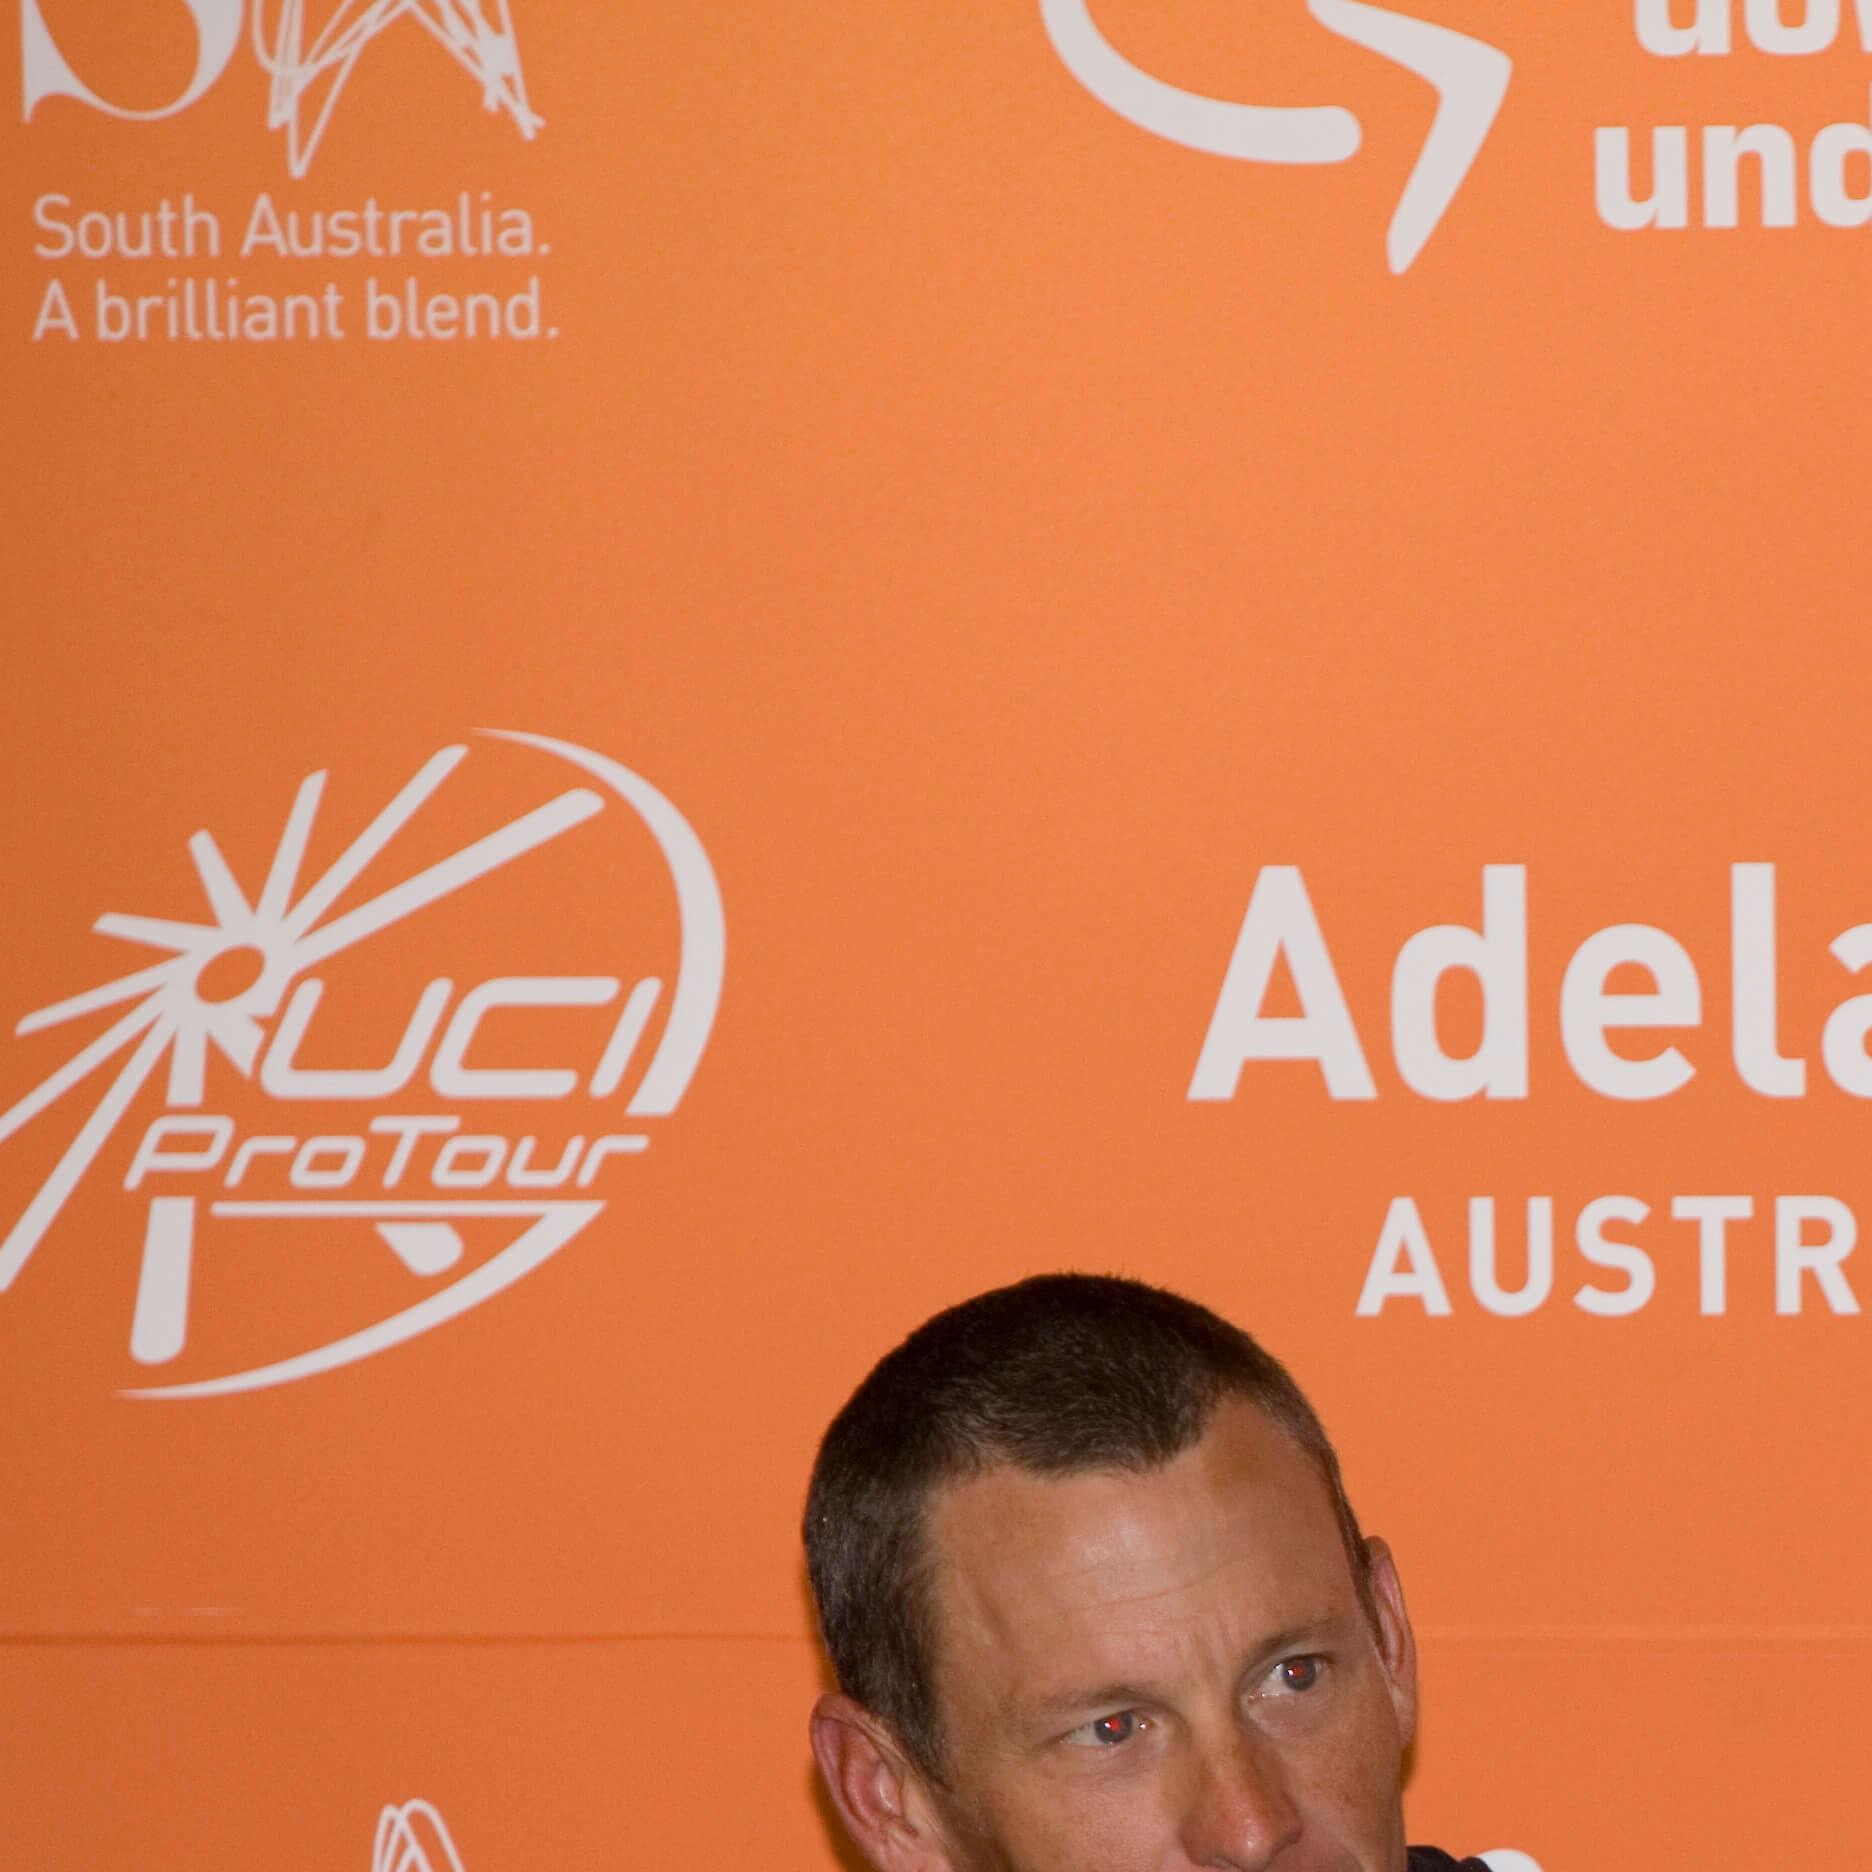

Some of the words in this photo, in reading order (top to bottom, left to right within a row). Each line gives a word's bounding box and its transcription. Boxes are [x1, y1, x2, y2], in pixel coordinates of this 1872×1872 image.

[33, 193, 220, 258] South
[241, 191, 550, 257] Australia.
[33, 279, 79, 340] A
[97, 279, 344, 341] brilliant
[366, 276, 560, 340] blend.
[259, 976, 662, 1098] UCI
[124, 1115, 650, 1192] ProTour
